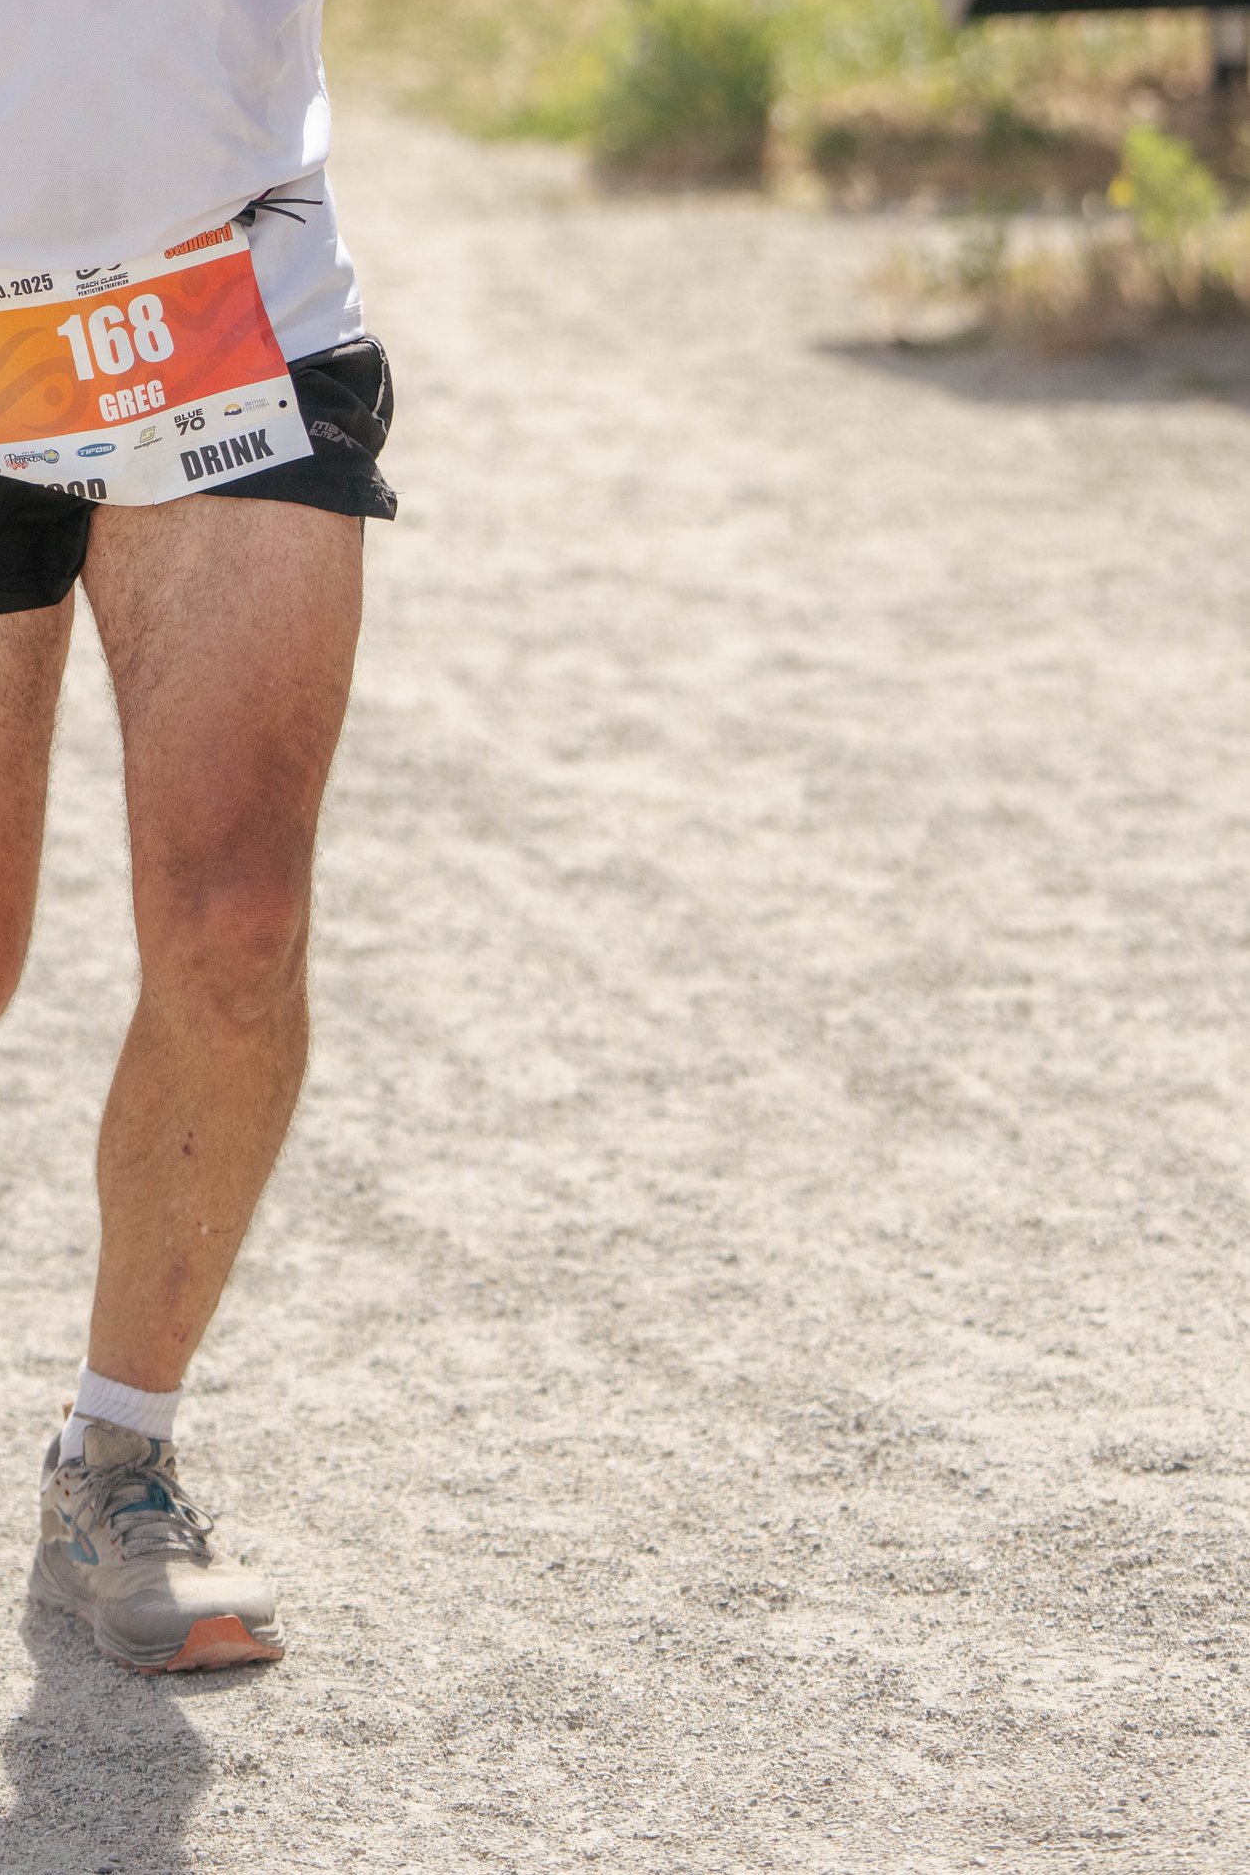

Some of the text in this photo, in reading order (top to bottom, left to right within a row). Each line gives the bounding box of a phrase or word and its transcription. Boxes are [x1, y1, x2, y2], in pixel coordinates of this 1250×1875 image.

[11, 273, 54, 296] 2025
[75, 272, 128, 291] PEACH CLASSIC
[77, 279, 129, 297] PENTICTON TRIATHLON
[56, 293, 175, 381] 168
[98, 379, 166, 422] GREG
[173, 408, 203, 424] BLUE
[176, 416, 206, 436] 70
[78, 445, 113, 456] TIFOSI
[180, 428, 275, 482] DRINK
[46, 478, 107, 500] OD
